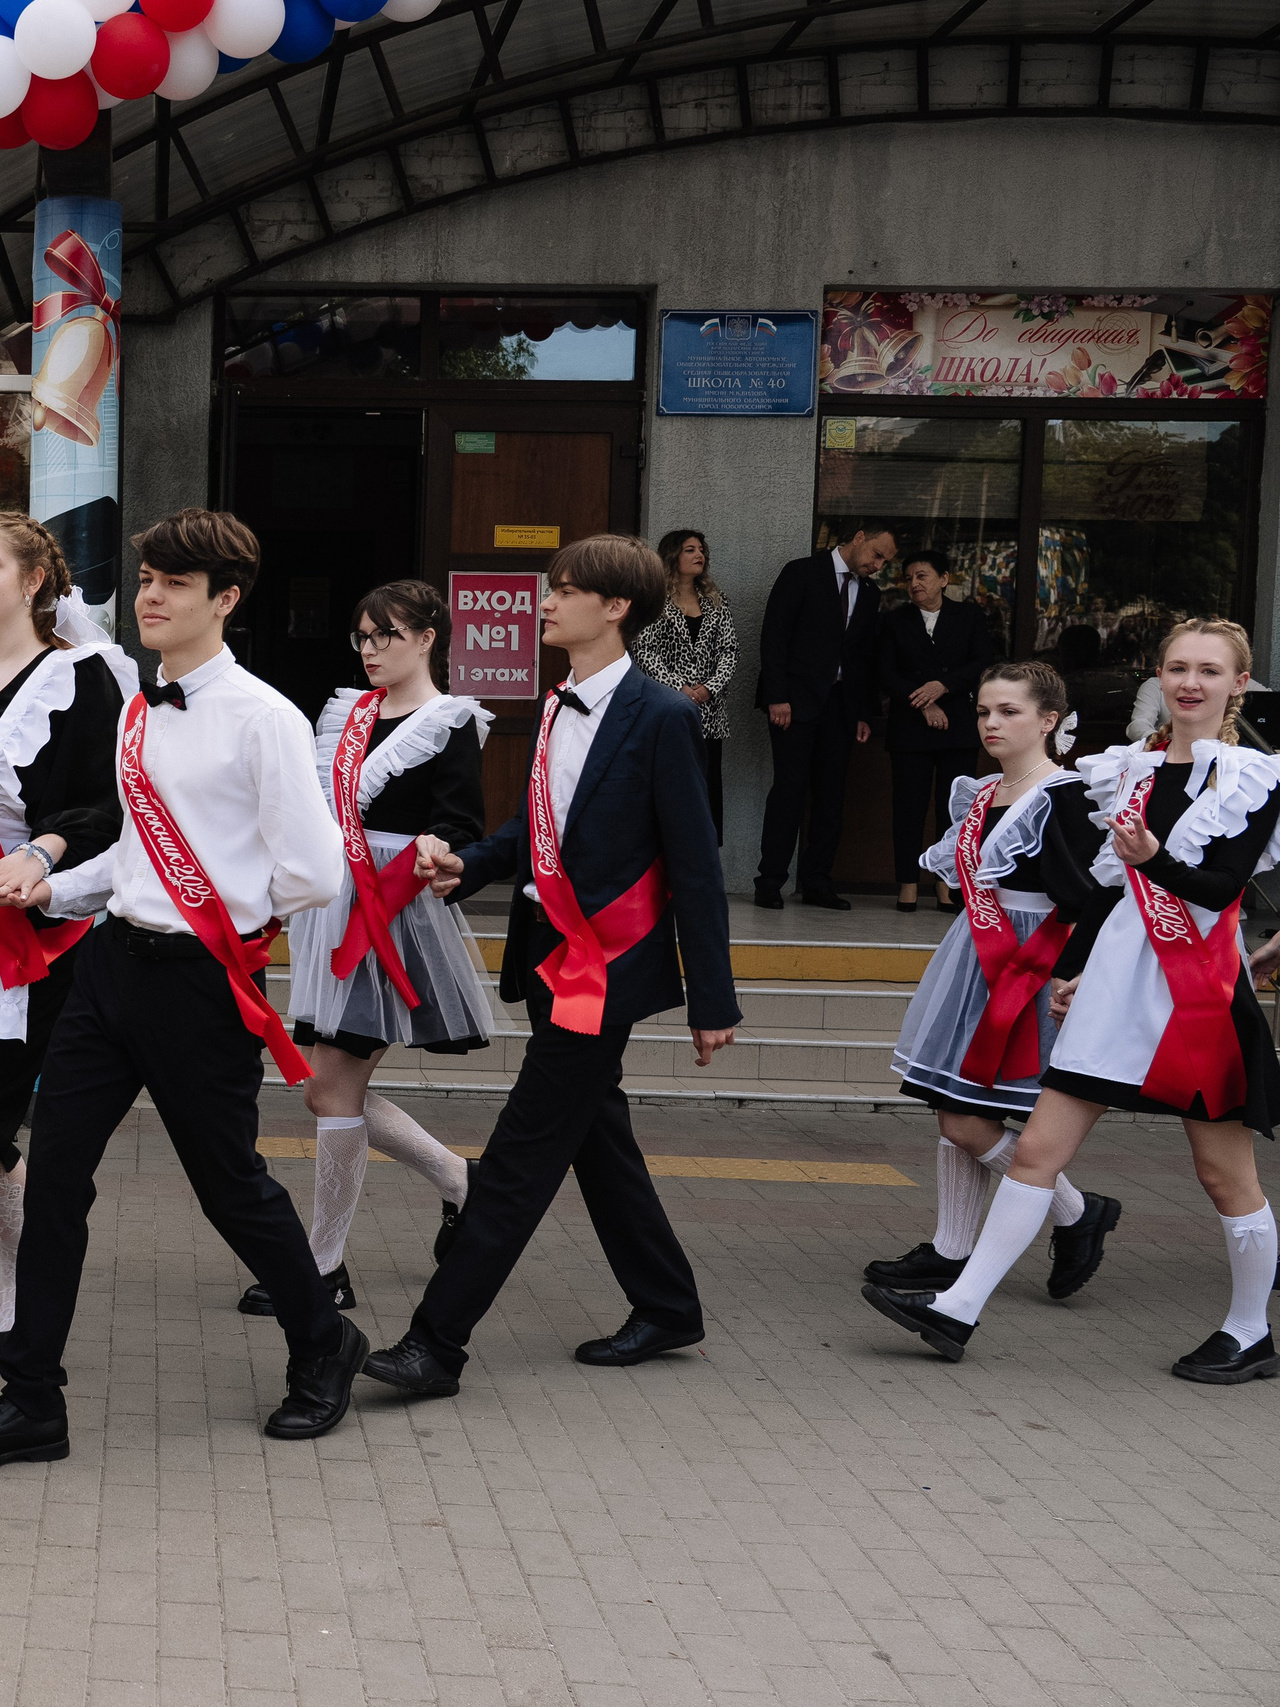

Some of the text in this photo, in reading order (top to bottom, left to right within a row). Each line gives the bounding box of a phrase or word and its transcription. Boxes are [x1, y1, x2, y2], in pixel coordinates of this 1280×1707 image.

[937, 309, 1141, 356] До свидания,
[688, 377, 786, 389] ШКОЛА № 40
[931, 356, 1047, 383] ШКОЛА!
[458, 590, 532, 614] ВХОД
[466, 624, 519, 651] №1
[457, 665, 529, 682] 1 этаж
[120, 748, 215, 908] Выпускник 2025
[345, 824, 369, 865] 2025
[972, 894, 1002, 932] 2025
[1152, 900, 1192, 944] 2025
